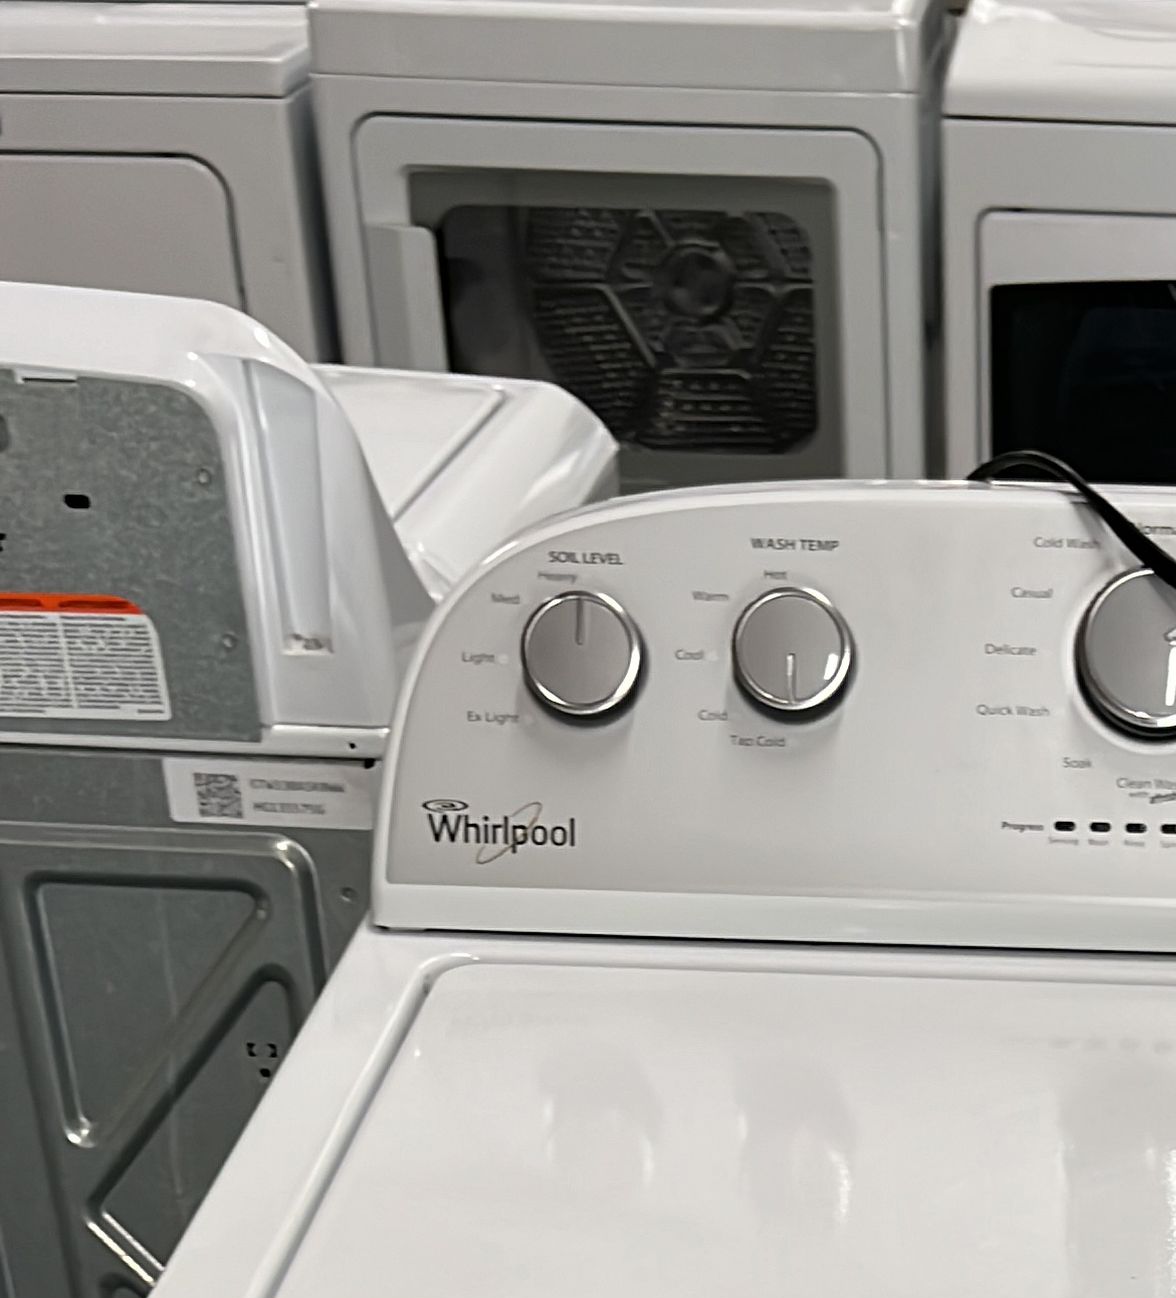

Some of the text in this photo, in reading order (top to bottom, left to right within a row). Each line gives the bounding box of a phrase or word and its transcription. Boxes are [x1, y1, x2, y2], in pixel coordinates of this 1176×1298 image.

[751, 537, 840, 552] WASH TEMP
[1033, 536, 1101, 550] Cold Wash
[548, 551, 624, 565] SOIL LEVEL
[1010, 586, 1054, 599] Casual
[674, 649, 704, 660] Cool
[984, 643, 1038, 656] Delicate
[461, 652, 496, 665] Light
[697, 709, 728, 721] Cold
[976, 704, 1051, 717] Quick Wash
[467, 711, 520, 725] Ex Light
[729, 735, 786, 747] Tap Cold
[1061, 757, 1093, 769] Soak
[1115, 777, 1152, 790] Clean
[428, 813, 576, 854] Whirlpool
